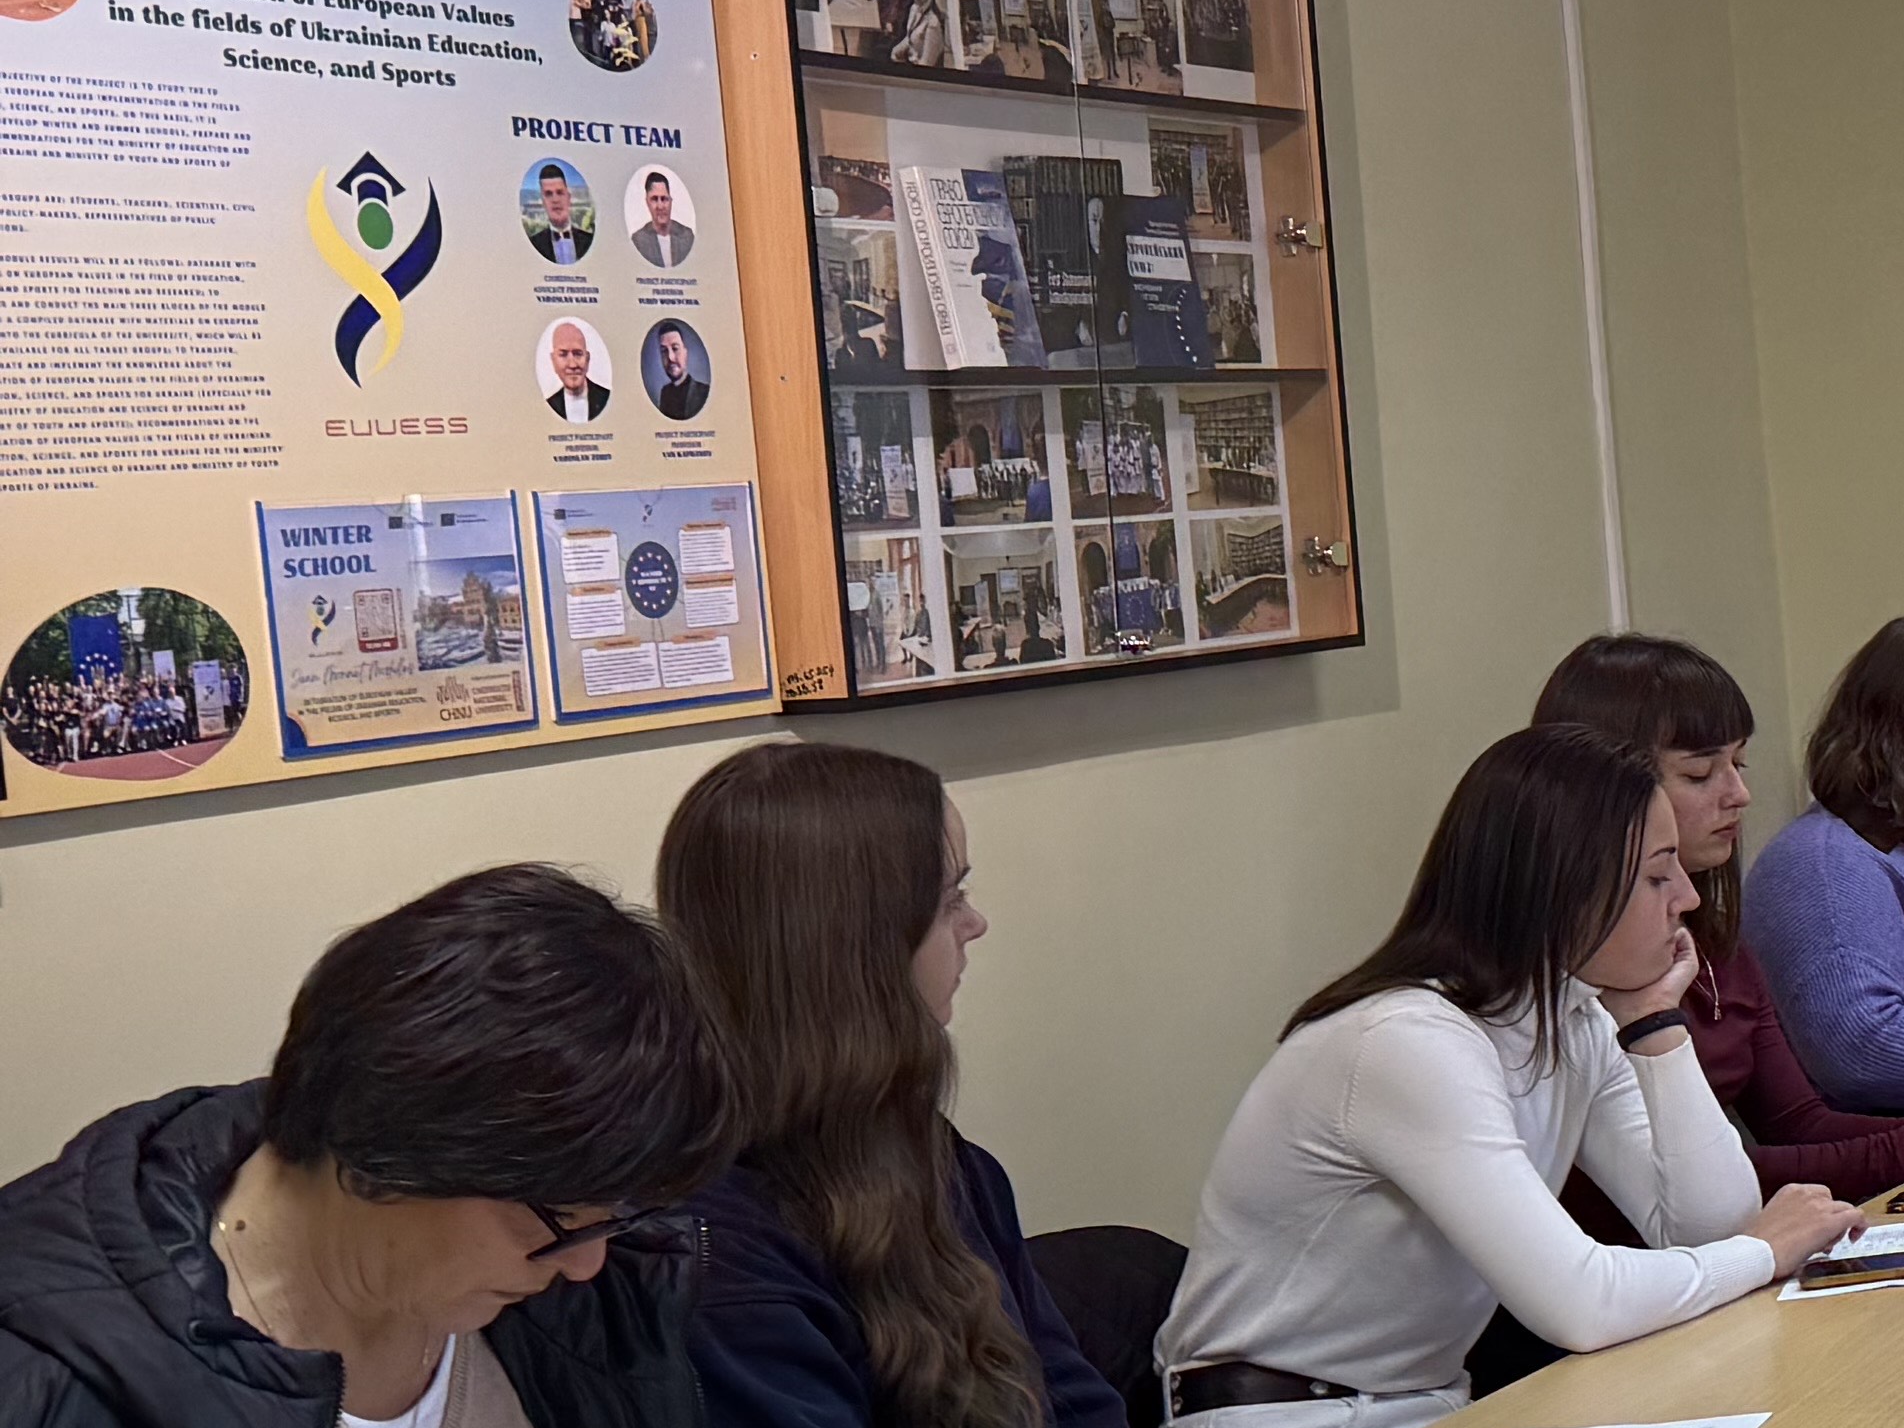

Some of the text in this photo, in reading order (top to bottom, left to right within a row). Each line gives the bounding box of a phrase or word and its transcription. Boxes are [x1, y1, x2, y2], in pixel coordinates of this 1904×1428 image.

[440, 2, 516, 28] Values
[142, 4, 185, 28] the
[192, 7, 263, 36] fields
[269, 18, 297, 39] of
[301, 19, 422, 52] Ukrainian
[427, 32, 543, 66] Education,
[222, 47, 457, 88] Science, and Sports
[510, 115, 683, 150] PROJECT TEAM
[280, 524, 374, 548] WINTER
[283, 554, 377, 579] SCHOOL
